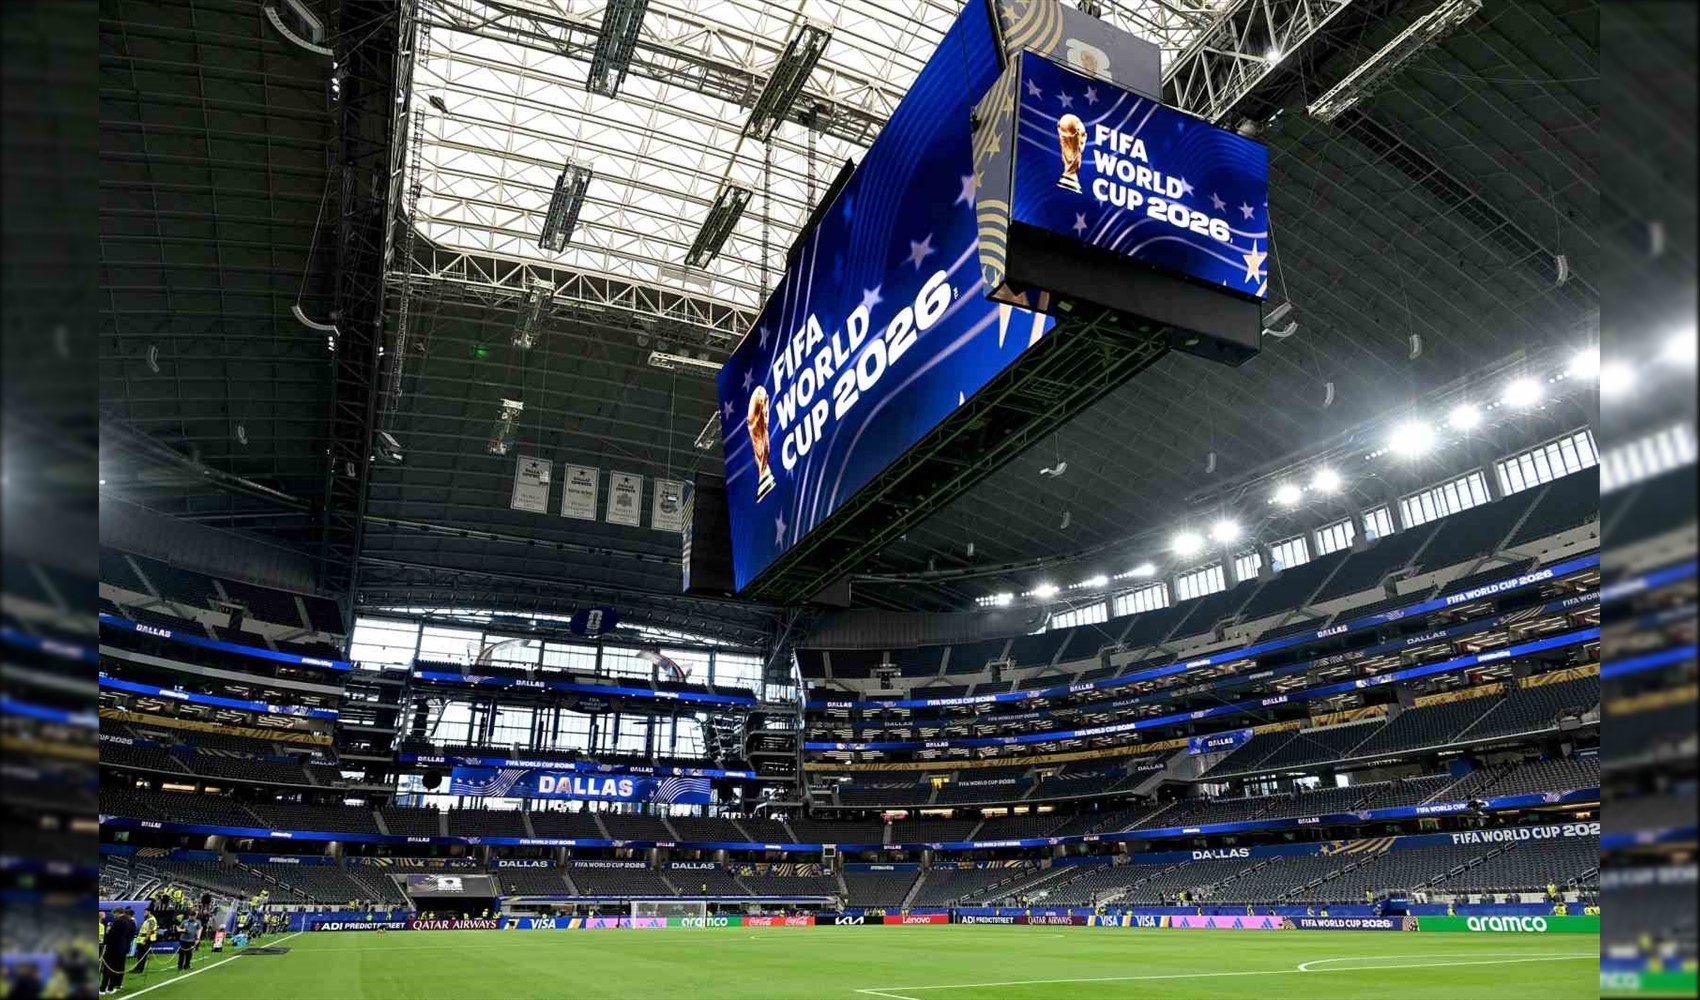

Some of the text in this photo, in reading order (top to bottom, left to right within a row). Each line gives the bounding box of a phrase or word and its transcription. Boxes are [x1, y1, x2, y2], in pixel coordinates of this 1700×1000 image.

[1095, 124, 1149, 163] FIFA
[1093, 150, 1183, 199] WORLD
[1092, 178, 1230, 243] CUP 2026
[772, 312, 825, 393] FIFA
[775, 304, 870, 431] WORLD
[781, 269, 951, 470] CUP 2026
[1446, 569, 1553, 605] FIFA WORLD CUP 2026
[1562, 597, 1579, 607] FIFA
[136, 624, 171, 638] DALLAS
[1317, 625, 1348, 639] DALLAS
[1406, 630, 1447, 645] DALLAS
[516, 680, 545, 688] DALLAS
[1070, 683, 1094, 692] DALLAS
[963, 696, 975, 704] CUP
[1112, 698, 1140, 707] DALLAS
[1262, 695, 1288, 706] DALLAS
[1207, 737, 1234, 747] DALLAS
[538, 775, 633, 797] DALLAS
[1416, 805, 1430, 814] FIFA
[1430, 804, 1452, 812] WORLD
[1453, 803, 1466, 811] CUP
[1298, 817, 1320, 825] DALLAS
[1452, 832, 1481, 845] FIFA
[1483, 828, 1530, 843] WORLD
[1532, 826, 1560, 839] CUP
[1192, 848, 1249, 860] DALLAS
[500, 860, 548, 868] DALLAS
[413, 920, 497, 930] QATAR AIRWAYS
[530, 918, 556, 928] VISA
[681, 917, 728, 927] aramco
[902, 915, 931, 924] Lenovo
[961, 916, 976, 924] ADI
[1028, 917, 1073, 925] QATAR AIRWAYS
[1100, 915, 1119, 927] VISA
[1135, 915, 1156, 927] VISA
[1301, 919, 1390, 928] FIFA WORLD CUP 2026
[1467, 915, 1548, 932] aramco
[321, 922, 343, 930] ADI
